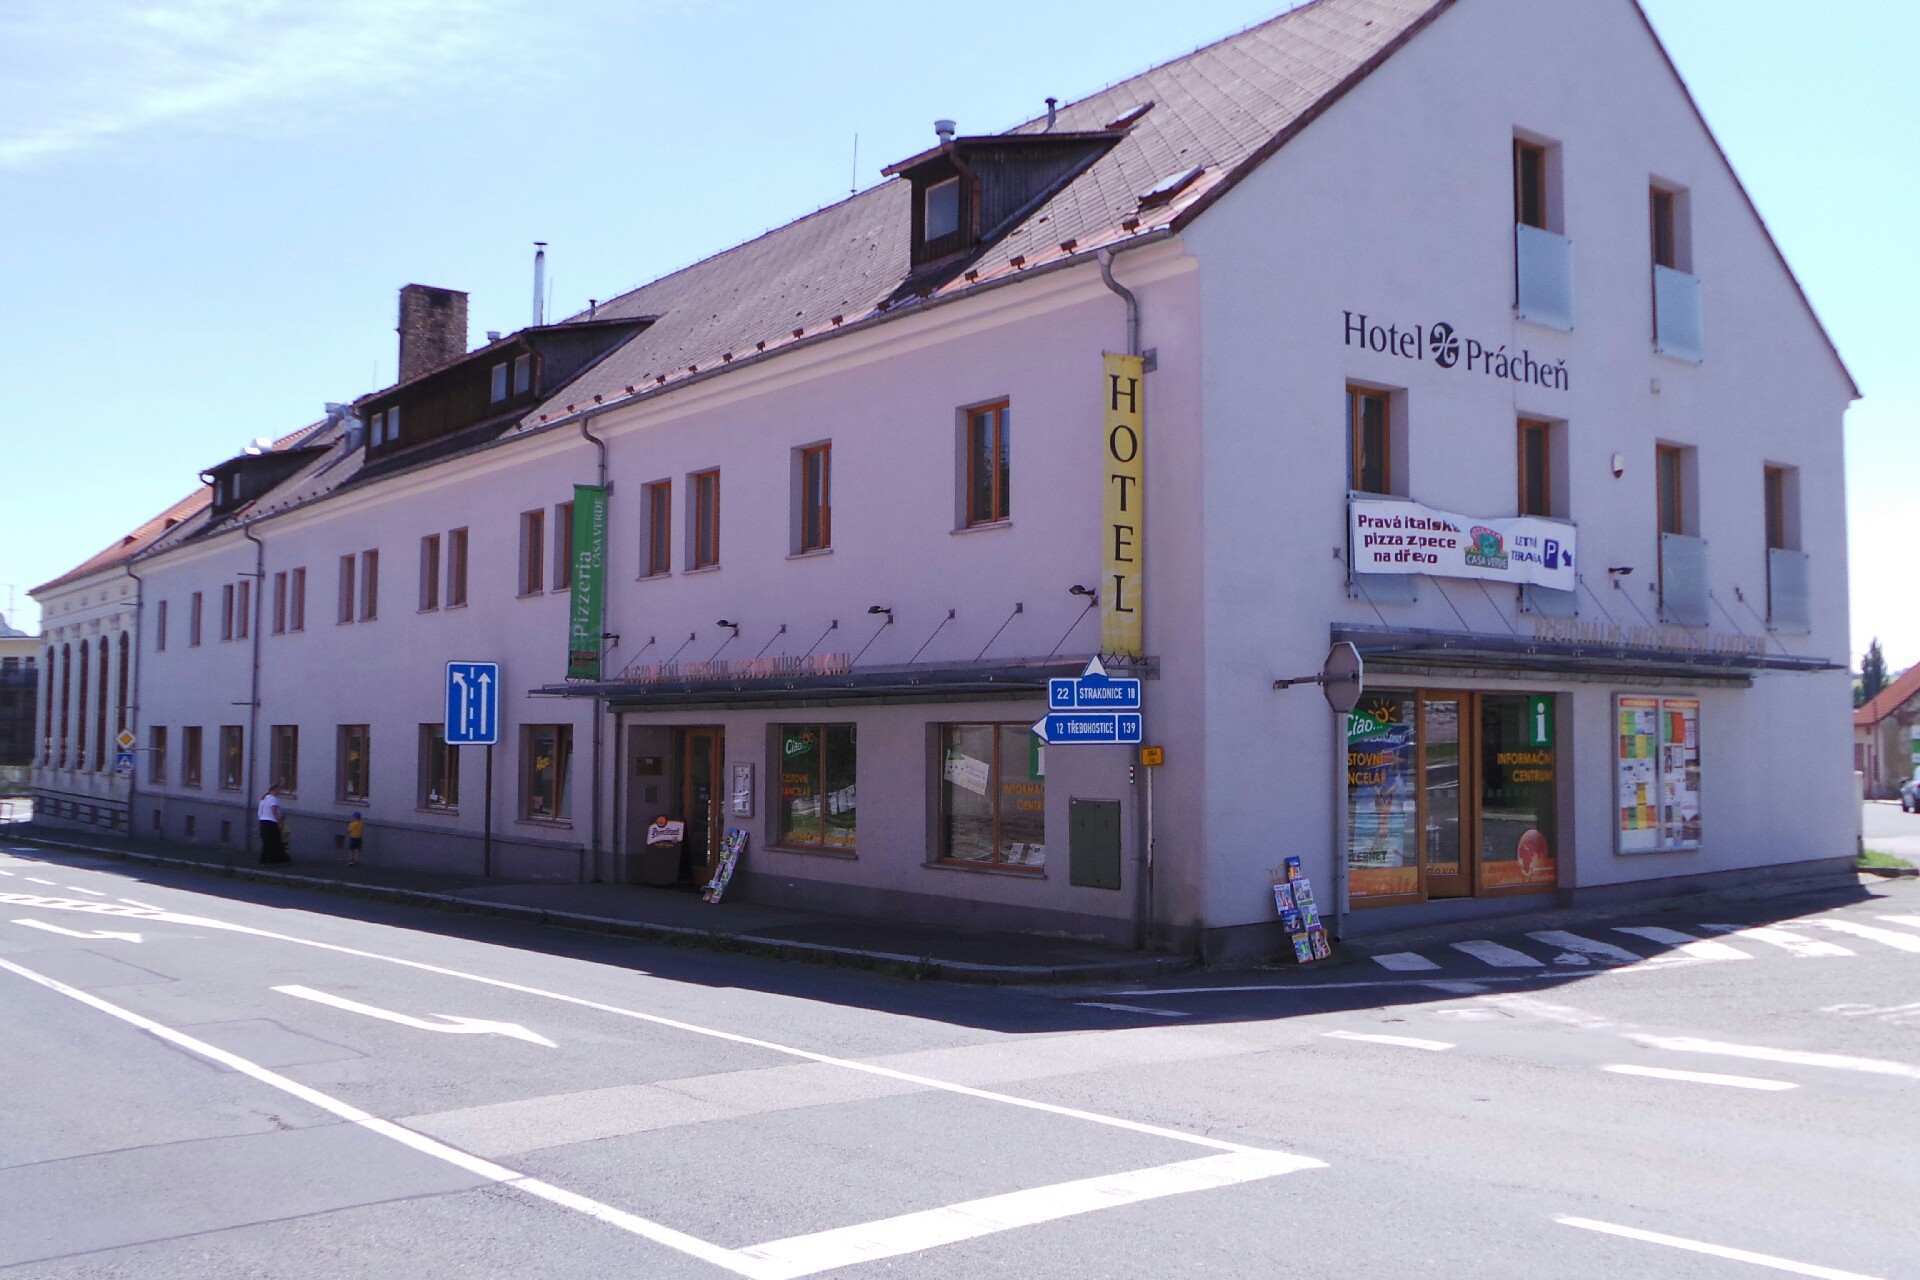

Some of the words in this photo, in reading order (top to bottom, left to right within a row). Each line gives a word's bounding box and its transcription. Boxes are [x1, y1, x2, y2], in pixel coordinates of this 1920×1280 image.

[1343, 310, 1423, 360] Hotel
[1465, 338, 1569, 391] Prácheň
[1109, 373, 1138, 613] HOTEL
[593, 497, 604, 537] VERDE
[1358, 514, 1402, 530] Pravá
[1364, 532, 1403, 547] pizza
[1406, 535, 1419, 545] z
[1419, 536, 1457, 549] pece
[592, 536, 602, 567] CASA
[1373, 552, 1391, 563] na
[1394, 548, 1438, 564] dřevo
[1466, 554, 1486, 566] CASA
[573, 551, 592, 638] Pizzeria
[1057, 688, 1069, 700] 22
[1079, 688, 1123, 699] STRAKONICE
[1056, 723, 1064, 735] 12
[1067, 720, 1114, 734] TŘEBOHOSTICE
[1122, 723, 1136, 734] 139
